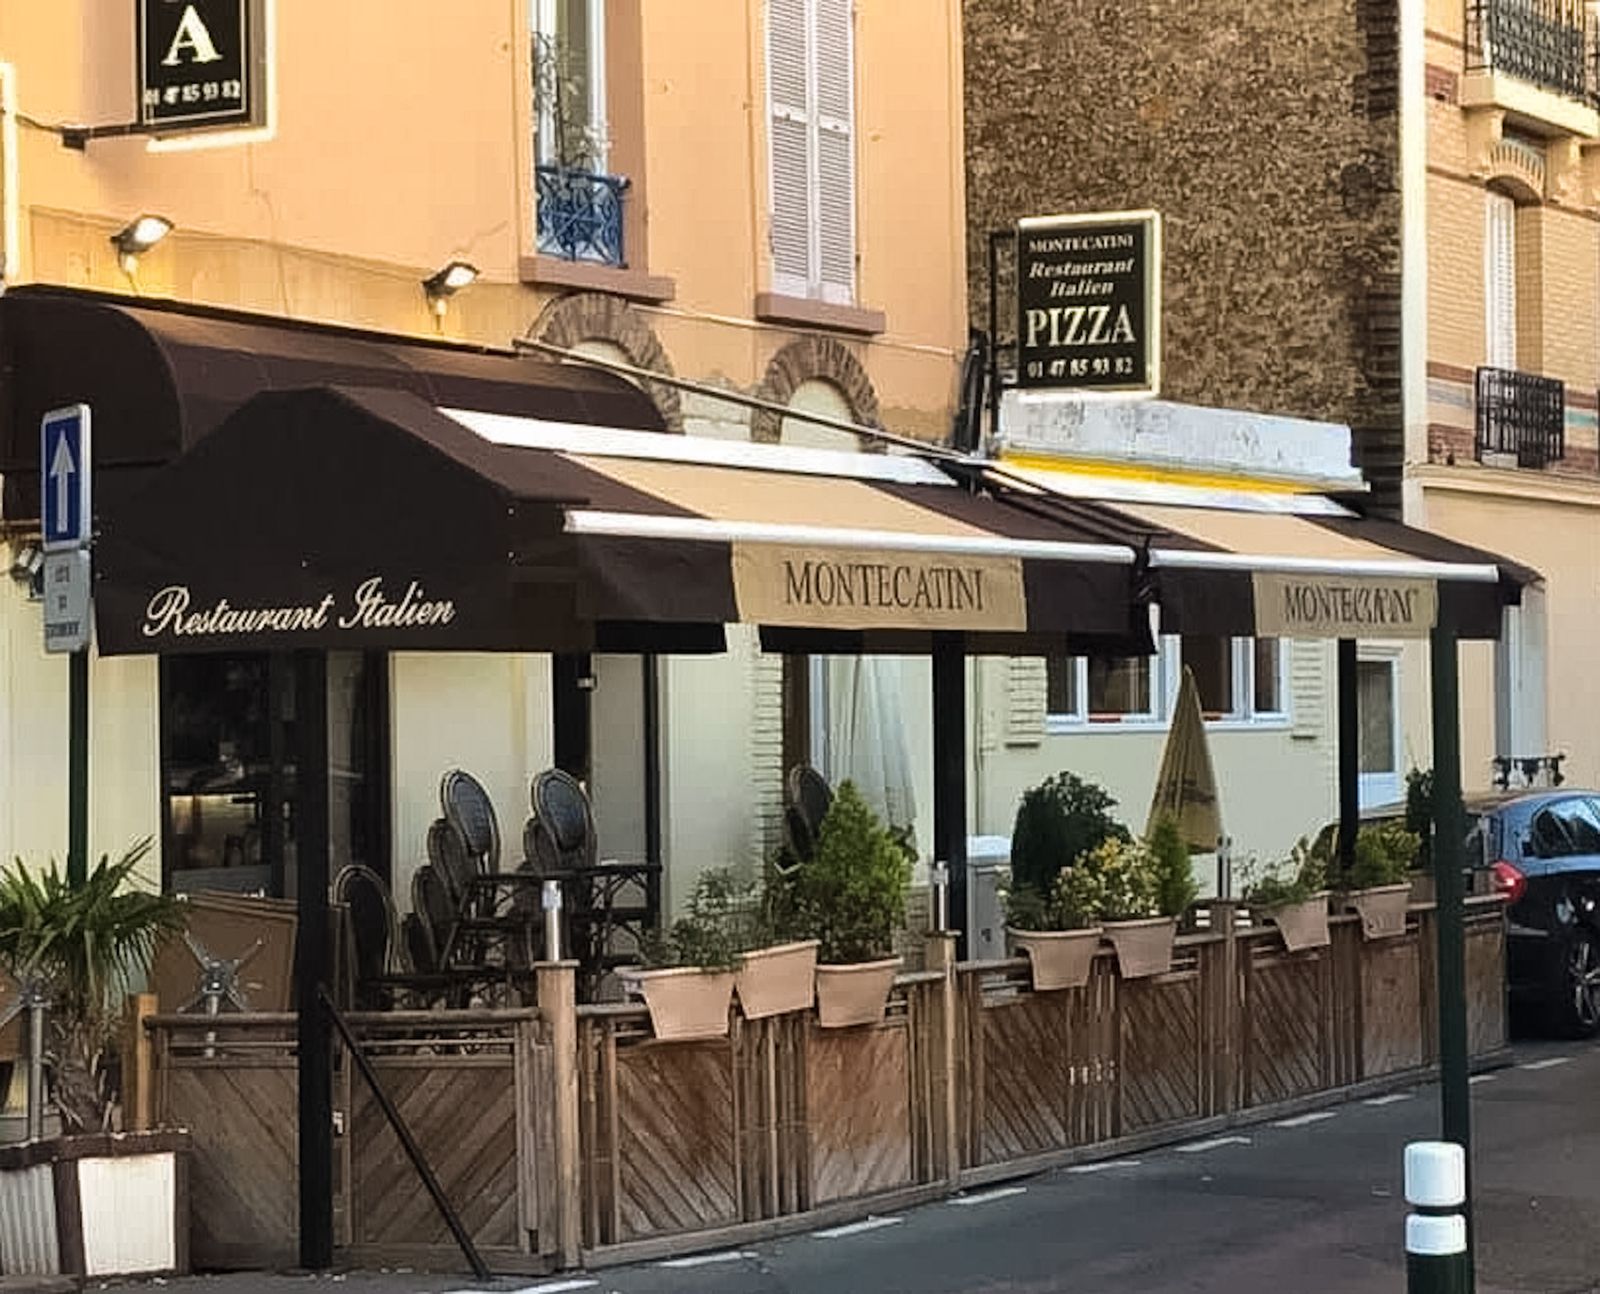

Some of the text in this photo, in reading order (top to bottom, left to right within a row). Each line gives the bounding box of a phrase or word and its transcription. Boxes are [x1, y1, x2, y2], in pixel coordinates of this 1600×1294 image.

[1028, 235, 1134, 253] MONTECATINI
[1028, 258, 1135, 278] Restaurant
[1050, 279, 1115, 298] Italien
[1025, 304, 1136, 347] PIZZA
[1027, 361, 1043, 378] 01
[1049, 359, 1066, 377] 47
[1092, 357, 1110, 375] 93
[784, 560, 984, 611] MONTECATINI
[143, 577, 455, 637] Restaurant Italien
